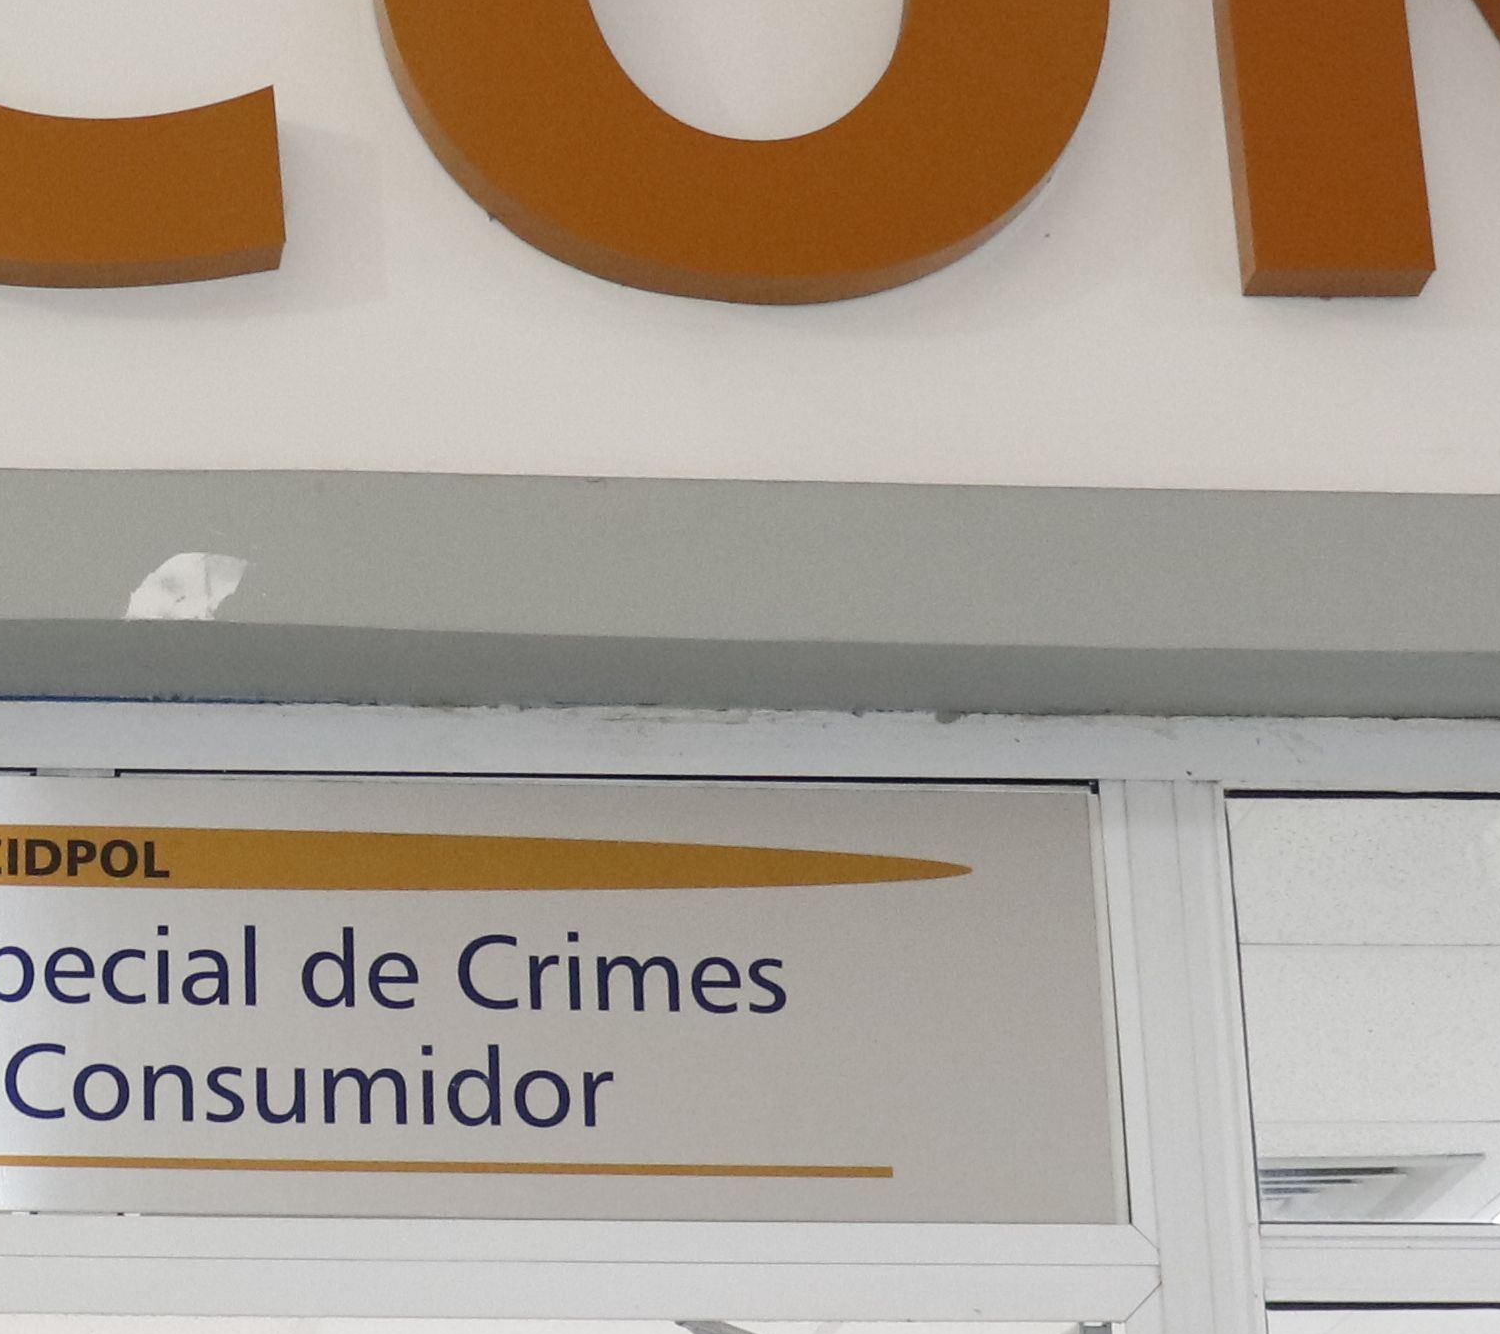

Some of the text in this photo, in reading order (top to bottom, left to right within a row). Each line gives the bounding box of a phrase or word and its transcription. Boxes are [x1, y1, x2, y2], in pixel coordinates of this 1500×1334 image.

[300, 924, 421, 1011] de
[456, 929, 789, 1016] Crimes
[3, 1041, 616, 1130] Consumidor
